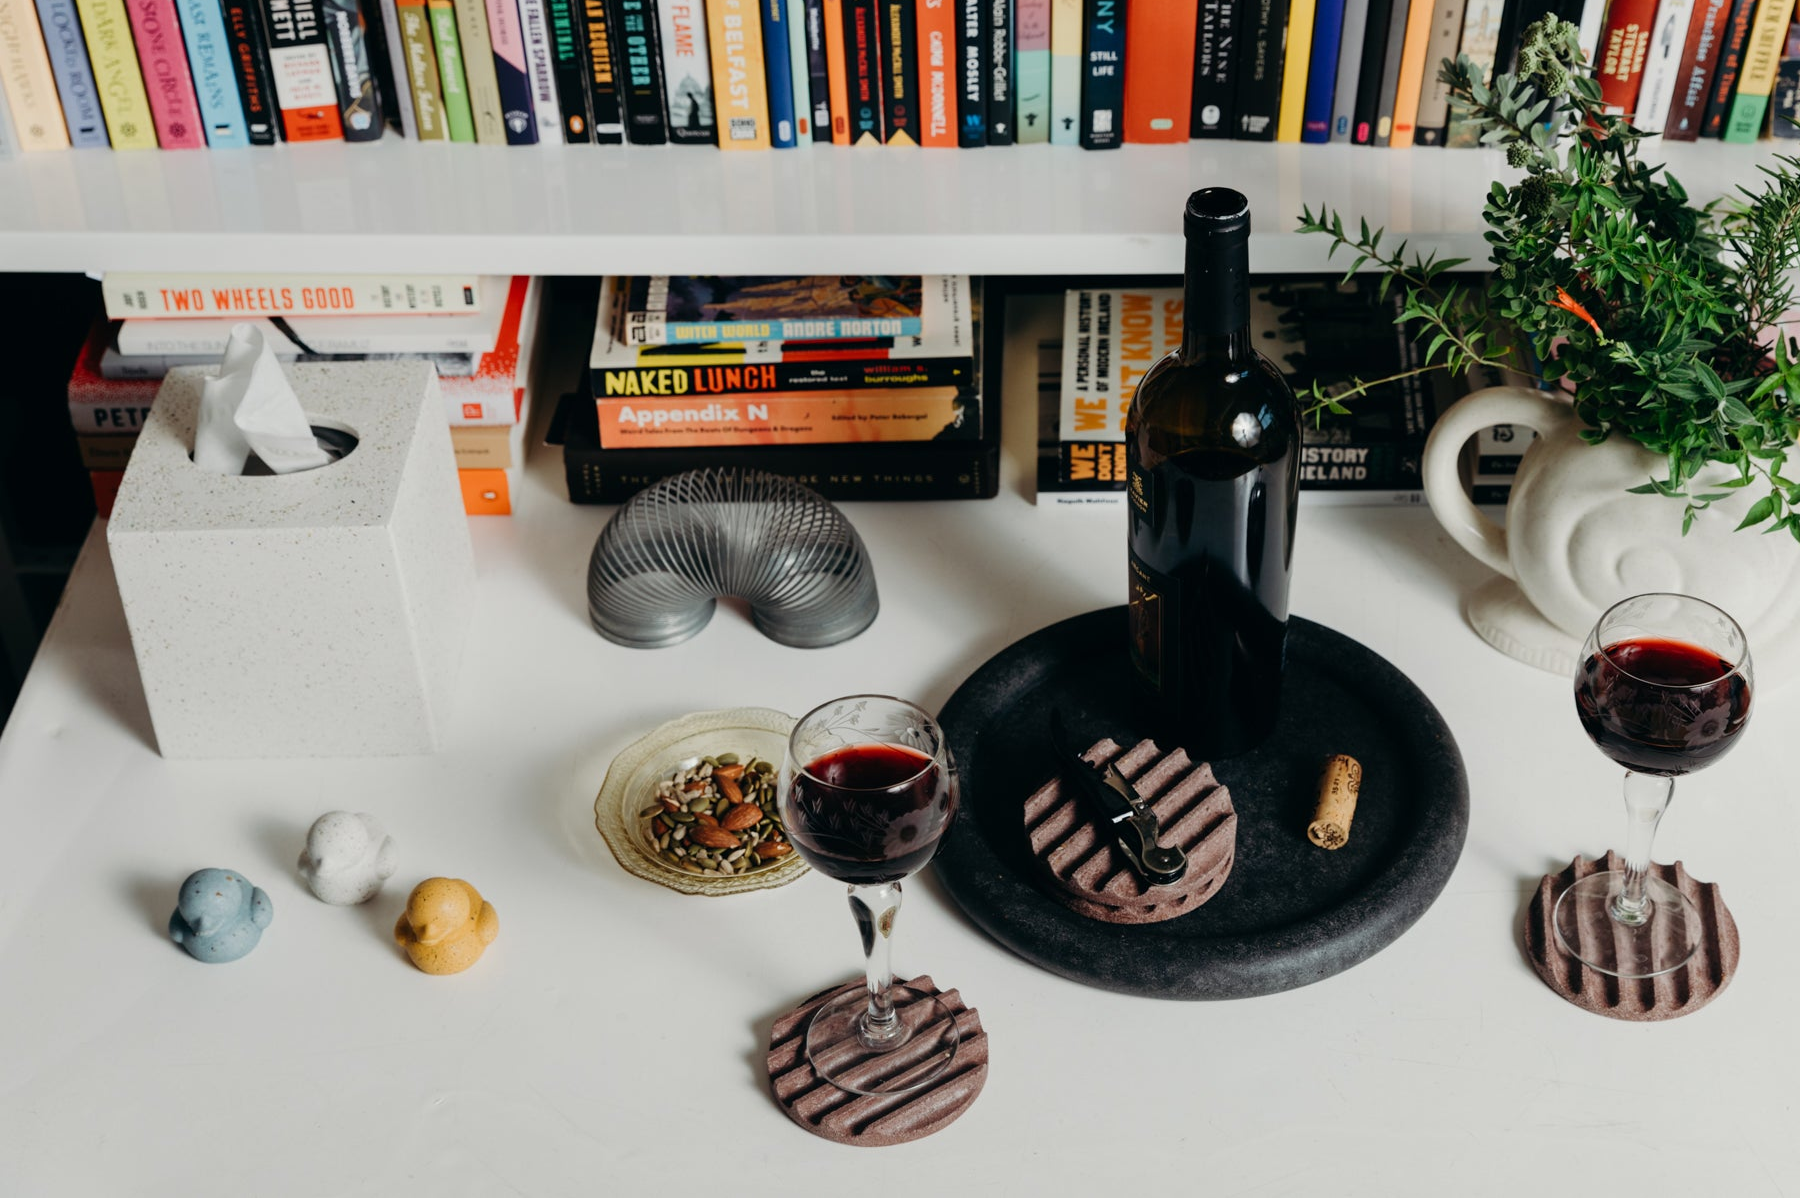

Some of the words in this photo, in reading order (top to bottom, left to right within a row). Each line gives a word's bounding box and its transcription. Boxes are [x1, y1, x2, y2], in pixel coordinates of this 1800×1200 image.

[92, 2, 117, 51] DARK
[230, 7, 247, 39] ELLY
[404, 12, 420, 37] The
[527, 9, 542, 45] FALLEN
[672, 5, 695, 57] FLAME
[1201, 1, 1219, 76] TAILORS
[197, 33, 224, 110] REMAINS
[588, 22, 613, 84] REQUIEM
[627, 36, 651, 86] OTHER
[724, 15, 749, 111] BELFAST
[993, 29, 1007, 102] Robbe-Grillet
[1090, 51, 1118, 62] STILL
[1092, 66, 1115, 77] LIFE
[1215, 35, 1233, 83] NINE
[1254, 40, 1267, 81] SAYERS
[1604, 28, 1625, 75] TAYLOR
[1617, 23, 1640, 82] STEWART
[1631, 30, 1649, 73] SARAH
[1726, 54, 1738, 68] of
[1751, 27, 1776, 81] SHUFFLE
[103, 56, 132, 114] ANGEL
[154, 59, 183, 117] CIRCLE
[238, 43, 262, 114] GRIFFITHS
[533, 50, 552, 102] SPARROW
[966, 46, 979, 102] MOSLEY
[1685, 66, 1706, 108] Affair
[1717, 73, 1736, 104] Time
[69, 71, 95, 121] ROOM
[160, 289, 205, 311] TWO
[211, 288, 294, 311] WHEELS
[302, 287, 355, 310] GOOD
[1078, 292, 1092, 333] HISTORY
[1098, 293, 1112, 335] IRELAND
[675, 325, 717, 340] WITCH
[721, 323, 770, 338] WORLD
[782, 321, 836, 337] ANDRE
[840, 320, 902, 336] NORTON
[1121, 294, 1153, 361] KNOW
[863, 365, 912, 374] william
[863, 374, 929, 384] burroughs
[1076, 336, 1090, 385] PERSONAL
[1097, 338, 1110, 379] MODERN
[605, 369, 689, 396] NAKED
[694, 365, 778, 392] LUNCH
[1096, 381, 1109, 392] OF
[618, 403, 741, 428] Appendix
[747, 404, 769, 421] N
[1074, 397, 1107, 432] WE
[1070, 444, 1095, 481] WE
[1113, 443, 1127, 482] KNOW
[1300, 465, 1367, 481] ELAND
[1302, 446, 1369, 464] ISTORY
[830, 475, 863, 484] NEW
[873, 475, 934, 484] THINGS
